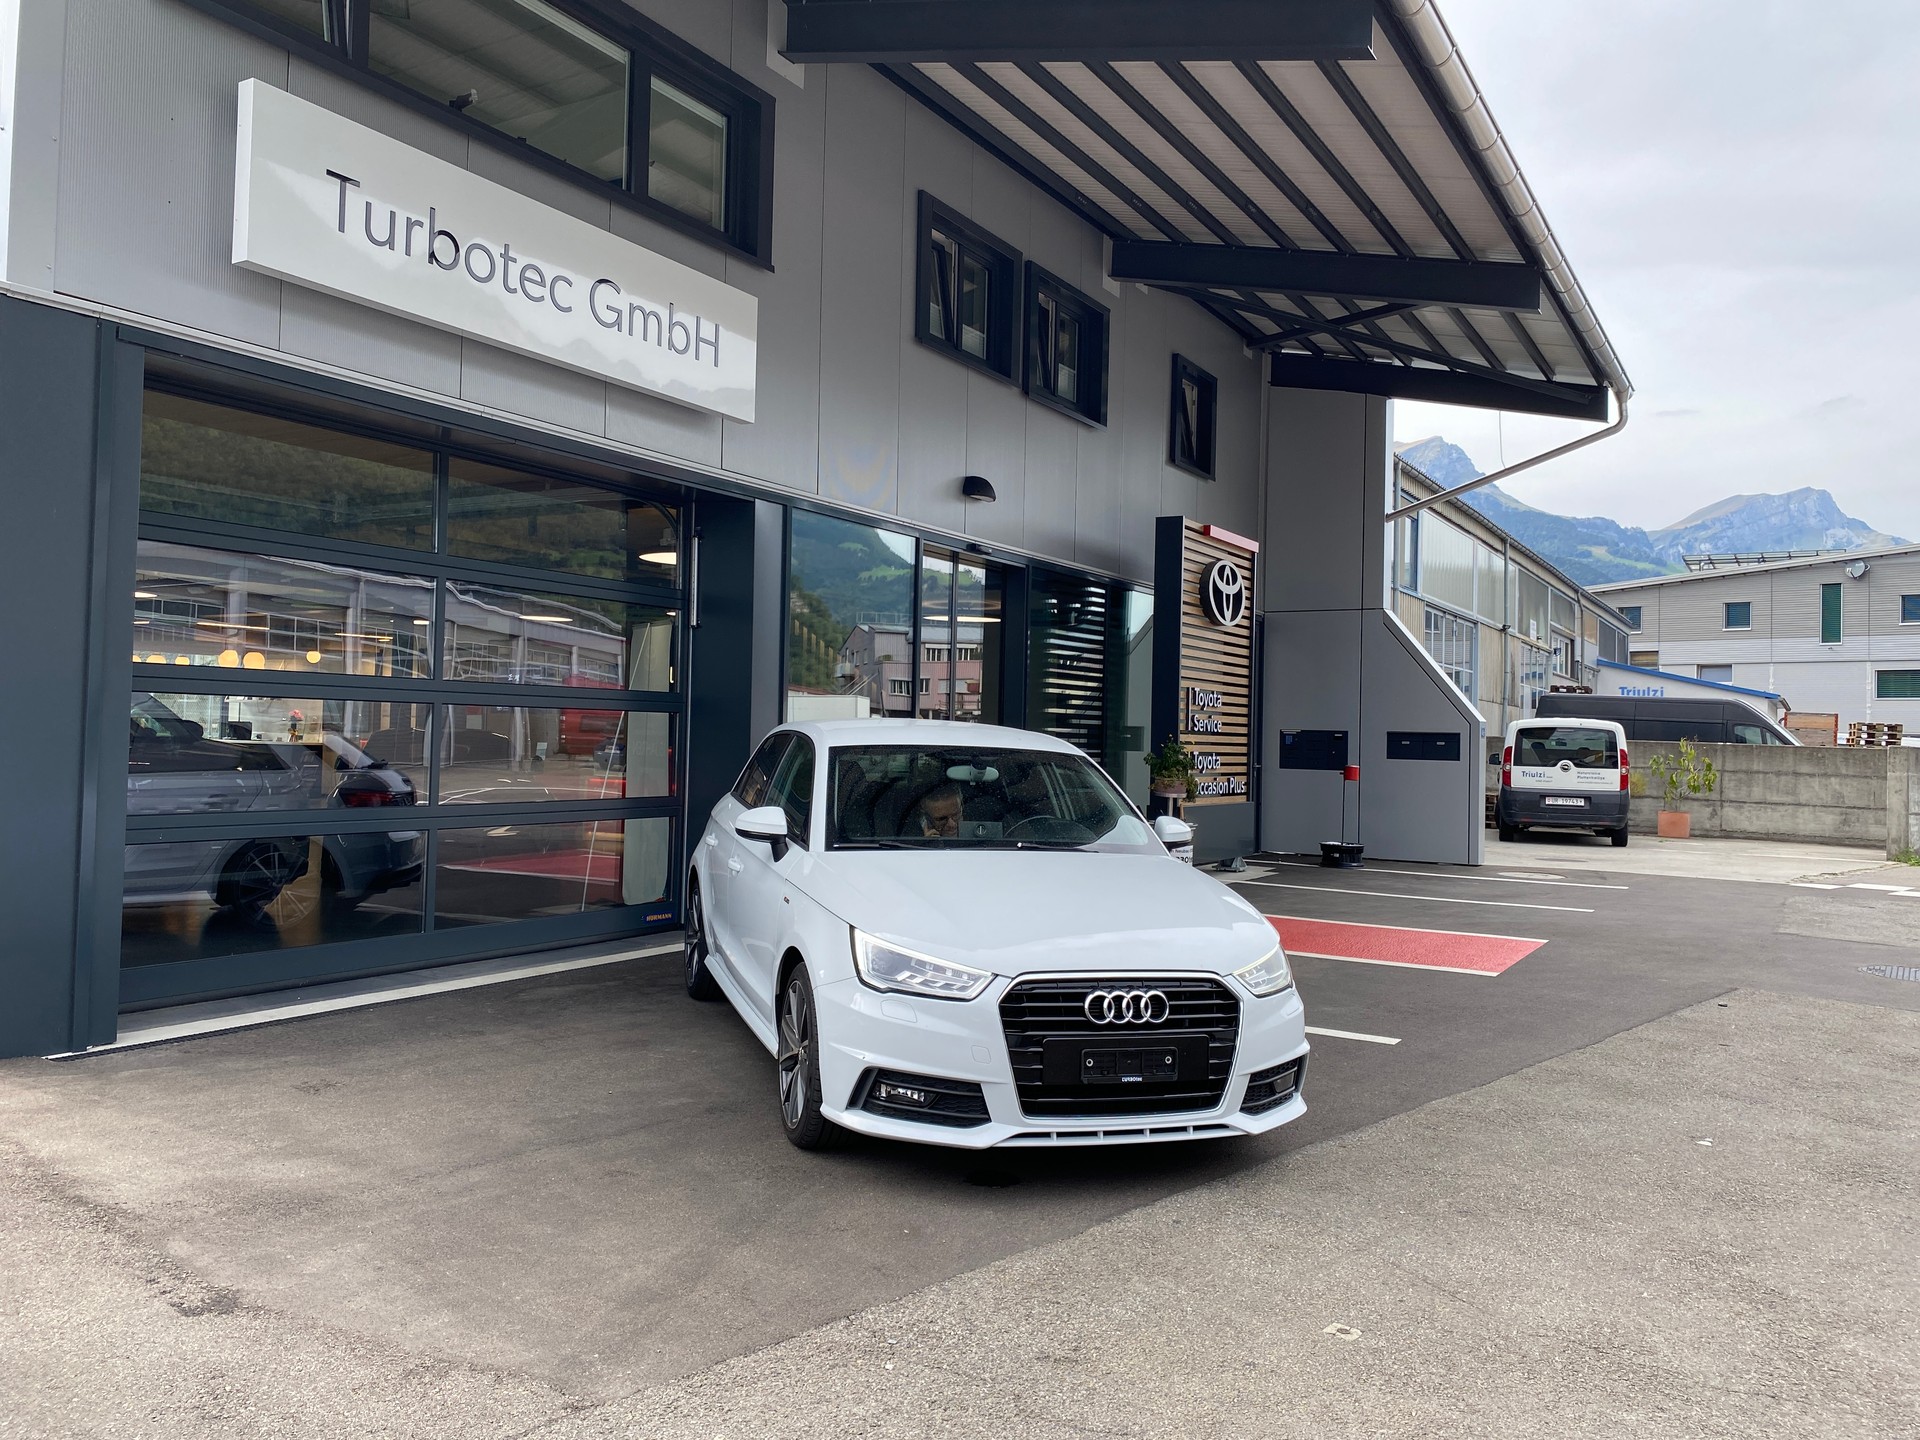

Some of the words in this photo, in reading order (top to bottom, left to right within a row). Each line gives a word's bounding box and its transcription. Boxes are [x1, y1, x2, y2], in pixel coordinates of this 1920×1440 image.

[326, 168, 574, 313] Turbotec
[589, 278, 720, 367] GmbH
[1194, 687, 1222, 711] Toyota
[1618, 686, 1664, 697] Triulzi
[1193, 714, 1222, 733] Service
[1193, 751, 1221, 774] Toyota
[1521, 770, 1546, 778] Triulzi
[1229, 776, 1245, 794] Plus
